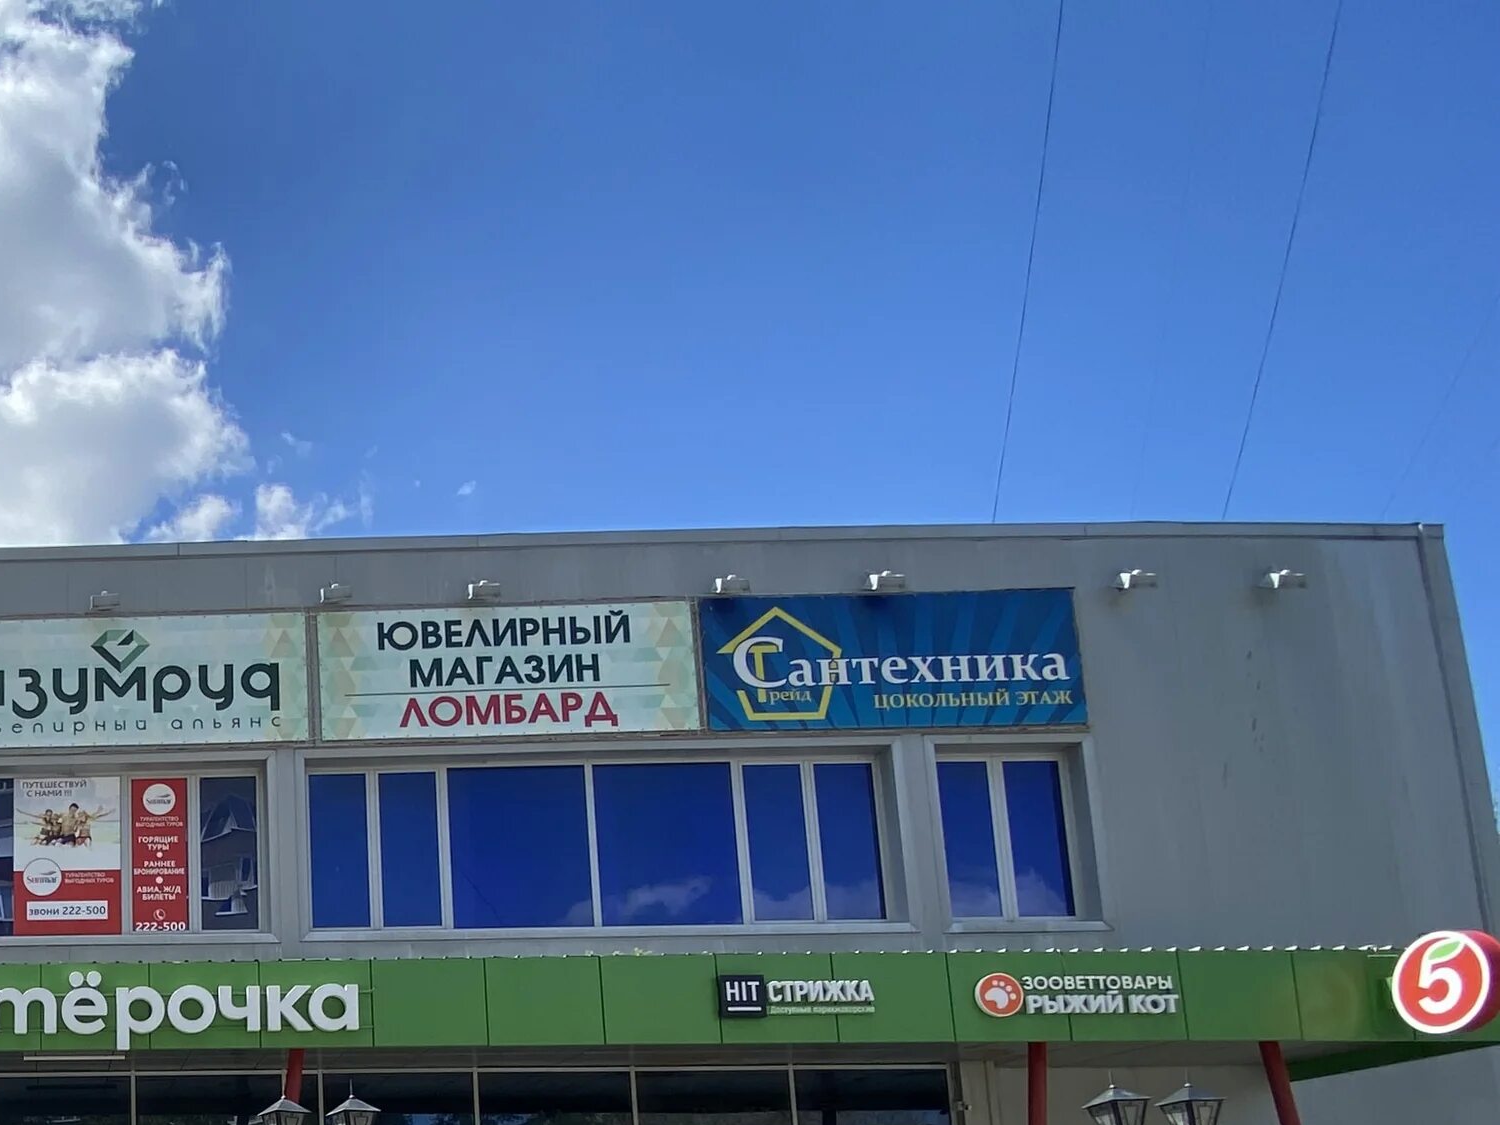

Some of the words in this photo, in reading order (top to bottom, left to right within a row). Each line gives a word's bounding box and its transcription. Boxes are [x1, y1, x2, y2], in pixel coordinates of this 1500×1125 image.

[376, 609, 631, 651] ЮВЕЛИРНЫЙ
[409, 653, 601, 688] МАГАЗИН
[733, 636, 1070, 689] Сантехника
[873, 687, 1010, 712] ЦОКОЛЬНЫЙ
[1015, 686, 1073, 706] ЭТАЖ
[400, 690, 618, 728] ЛОМБАРД
[171, 715, 281, 731] альянс
[22, 779, 87, 789] ПУТЕШЕСТВУЙ
[138, 836, 179, 844] ГОРЯЩИЕ
[142, 893, 176, 901] БИЛЕТЫ
[163, 885, 182, 894] Ж/Д
[62, 905, 106, 915] 222-500
[135, 922, 186, 931] 222-500
[725, 981, 760, 1002] HIT
[766, 980, 875, 1002] СТРИЖКА
[1022, 975, 1173, 991] ЗООВЕТТОВАРЫ
[1025, 990, 1124, 1015] РЫЖИЙ
[1129, 993, 1179, 1014] КОТ
